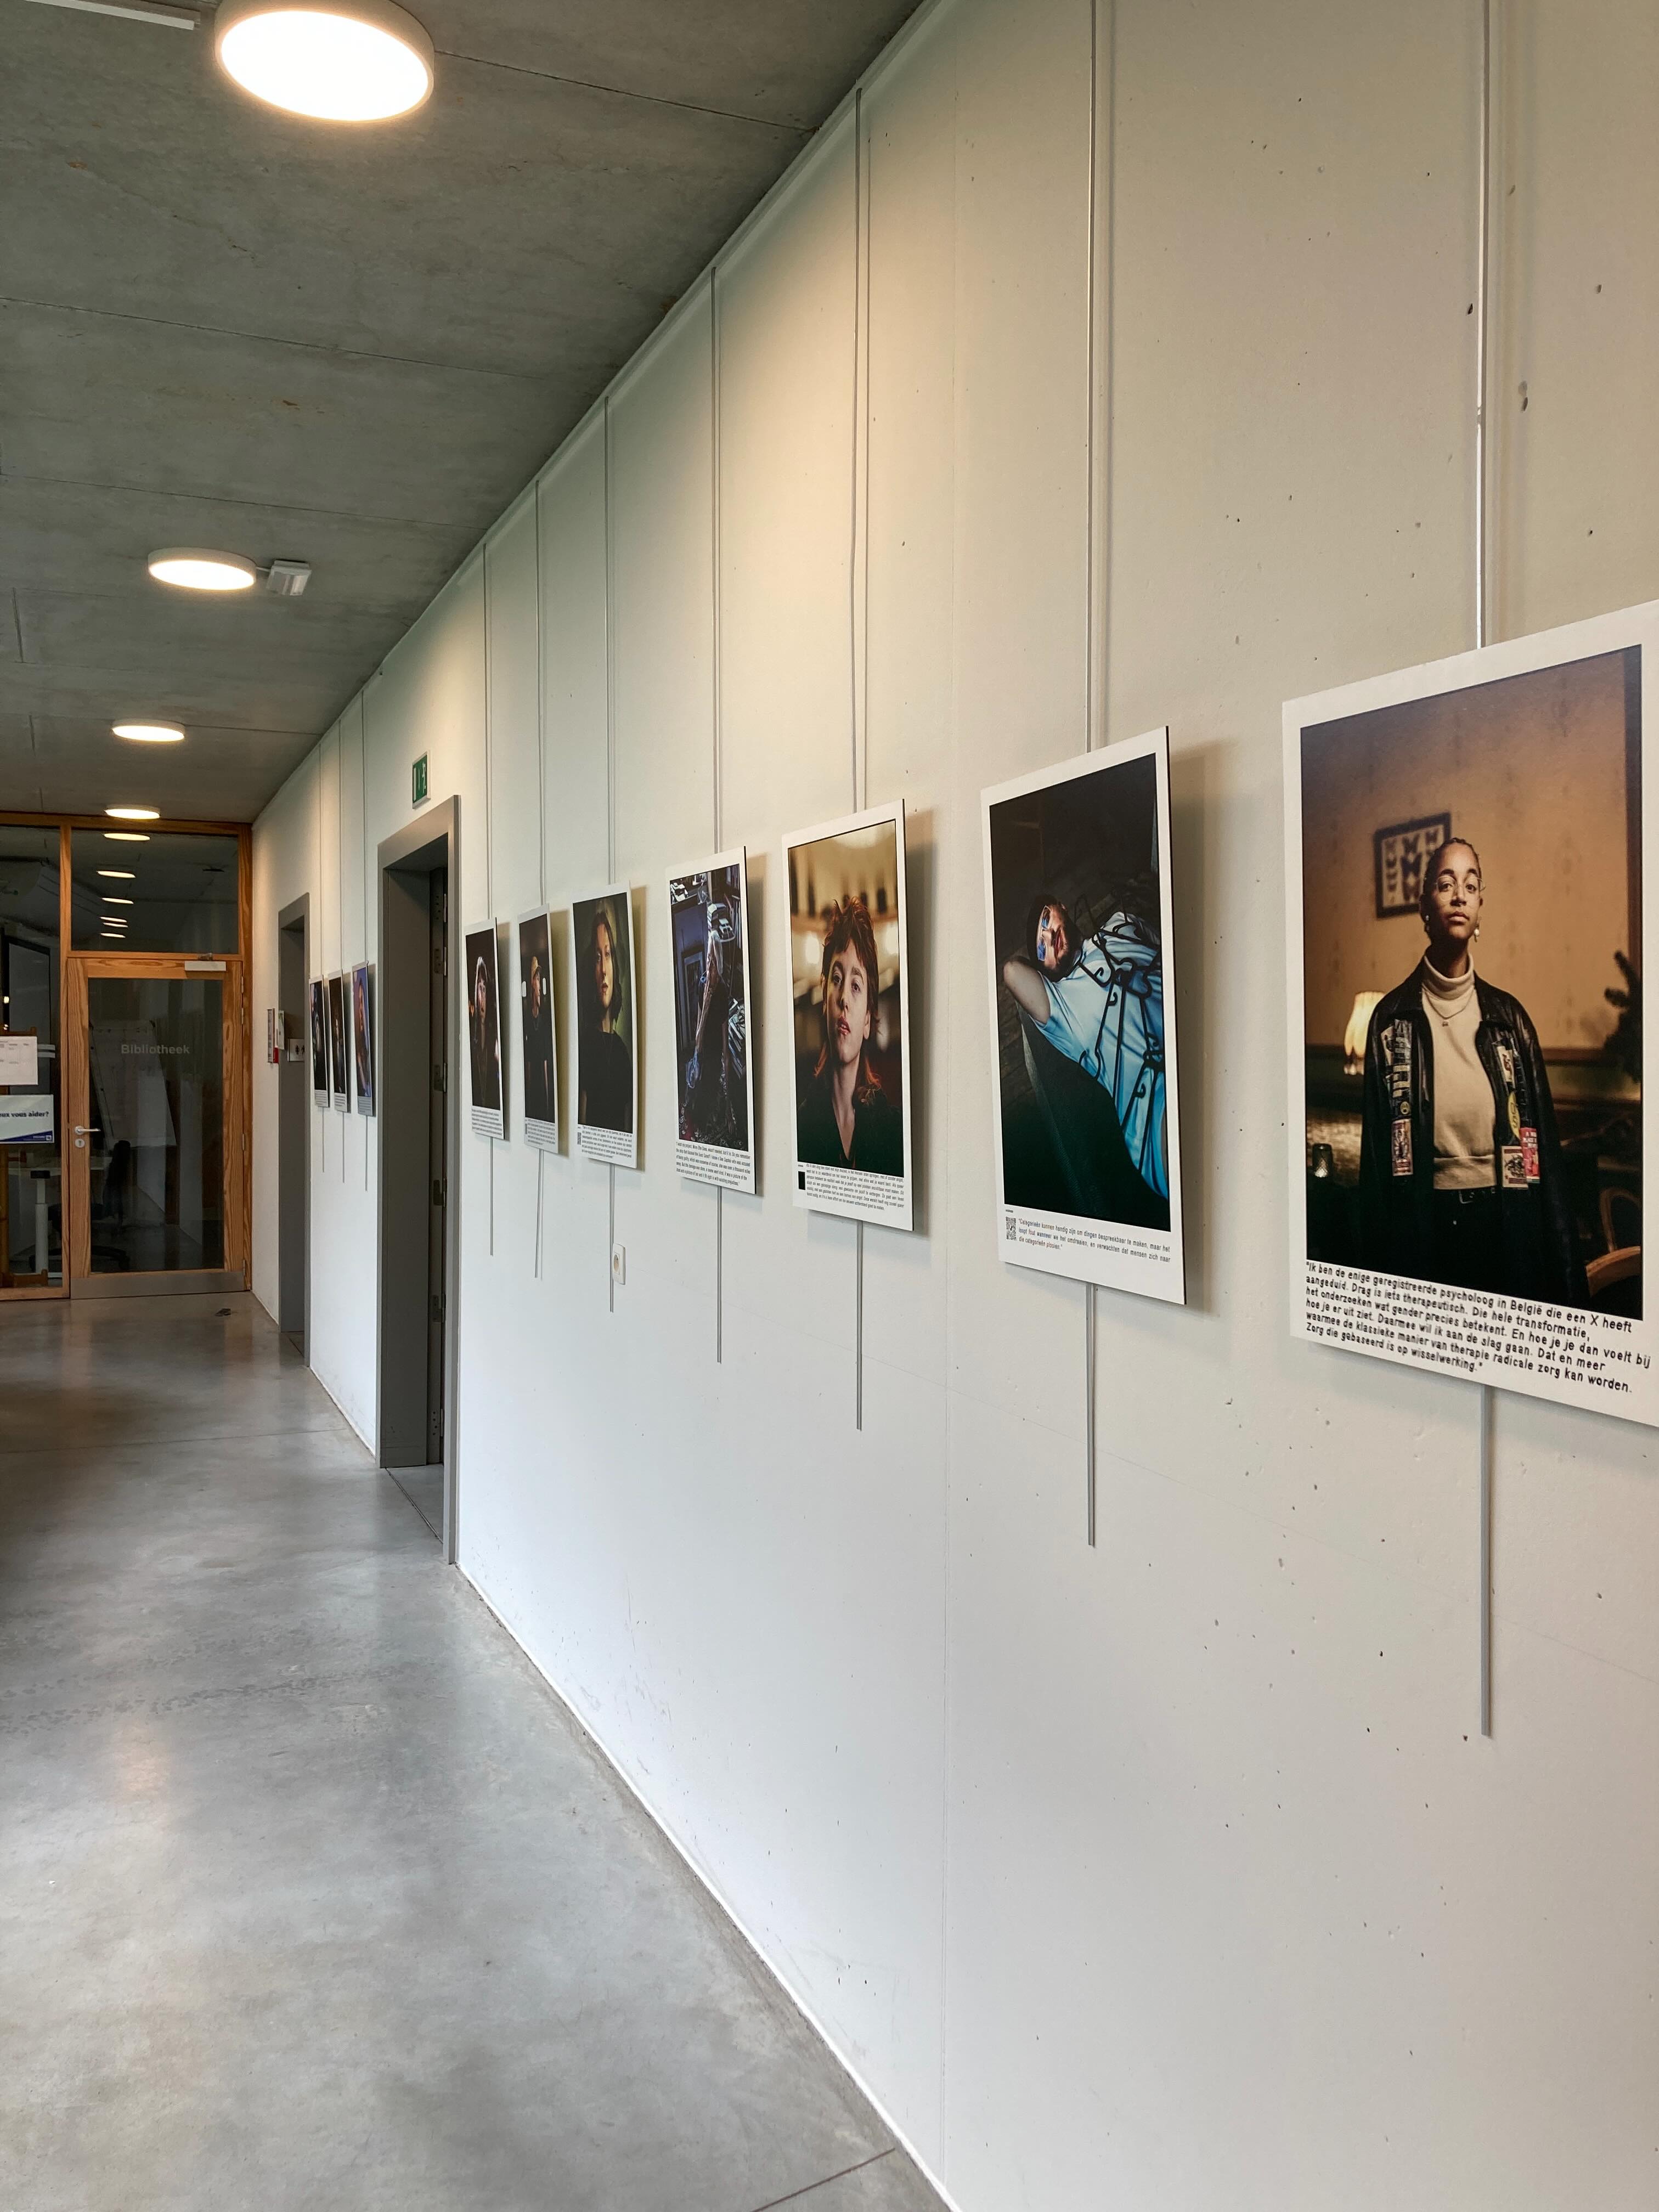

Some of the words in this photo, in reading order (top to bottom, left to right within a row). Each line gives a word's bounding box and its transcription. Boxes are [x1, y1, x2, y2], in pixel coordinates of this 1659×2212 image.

[121, 1044, 190, 1054] Bibliotheek
[1306, 1261, 1316, 1271] "Ik
[1318, 1263, 1332, 1274] ben
[1335, 1268, 1345, 1277] de
[1347, 1272, 1370, 1283] enige
[1373, 1277, 1437, 1294] geregistreerde
[1440, 1289, 1493, 1308] psycholoog
[1498, 1298, 1506, 1308] in
[1510, 1300, 1542, 1315] België
[1546, 1307, 1561, 1318] die
[1566, 1313, 1585, 1323] een
[1590, 1314, 1598, 1326] X
[1602, 1317, 1632, 1333] heeft
[1306, 1276, 1348, 1290] aangeduid.
[1352, 1283, 1371, 1297] Drag
[1384, 1290, 1400, 1300] iets
[1403, 1294, 1468, 1313] therapeutisch.
[1472, 1306, 1487, 1318] Die
[1492, 1311, 1513, 1323] hele
[1515, 1316, 1589, 1341] transformatie,
[1306, 1286, 1318, 1296] het
[1321, 1291, 1372, 1307] onderzoeken
[1375, 1302, 1389, 1311] wat
[1392, 1306, 1424, 1317] gender
[1425, 1313, 1459, 1326] precies
[1463, 1318, 1507, 1335] betekent.
[1511, 1328, 1524, 1340] En
[1528, 1331, 1547, 1344] hoe
[1549, 1336, 1560, 1348] je
[1563, 1339, 1575, 1351] je
[1579, 1342, 1598, 1355] dan
[1603, 1349, 1632, 1362] voelt
[1636, 1353, 1650, 1368] bij
[1306, 1298, 1319, 1308] hoe
[1321, 1302, 1330, 1312] je
[1344, 1307, 1354, 1316] uit
[1356, 1311, 1375, 1321] ziet.
[1378, 1313, 1415, 1329] Daarmee
[1419, 1324, 1431, 1333] wil
[1434, 1326, 1443, 1336] ik
[1446, 1330, 1463, 1340] aan
[1466, 1333, 1477, 1343] de
[1481, 1337, 1501, 1351] slag
[1505, 1344, 1533, 1355] gaan.
[1538, 1348, 1555, 1361] Dat
[1559, 1355, 1572, 1364] en
[1576, 1358, 1605, 1370] meer
[1306, 1322, 1323, 1336] Zorg
[1326, 1327, 1338, 1337] die
[1341, 1332, 1384, 1348] gebaseerd
[1397, 1346, 1408, 1355] op
[1411, 1349, 1482, 1372] wisselwerking."
[1306, 1312, 1340, 1325] waarmee
[1343, 1319, 1353, 1328] de
[1356, 1321, 1395, 1338] klassieke
[1398, 1333, 1429, 1345] manier
[1431, 1340, 1447, 1350] van
[1450, 1343, 1489, 1359] therapie
[1493, 1354, 1533, 1369] radicale
[1537, 1364, 1560, 1378] zorg
[1565, 1368, 1583, 1381] kan
[1588, 1375, 1632, 1392] worden.
